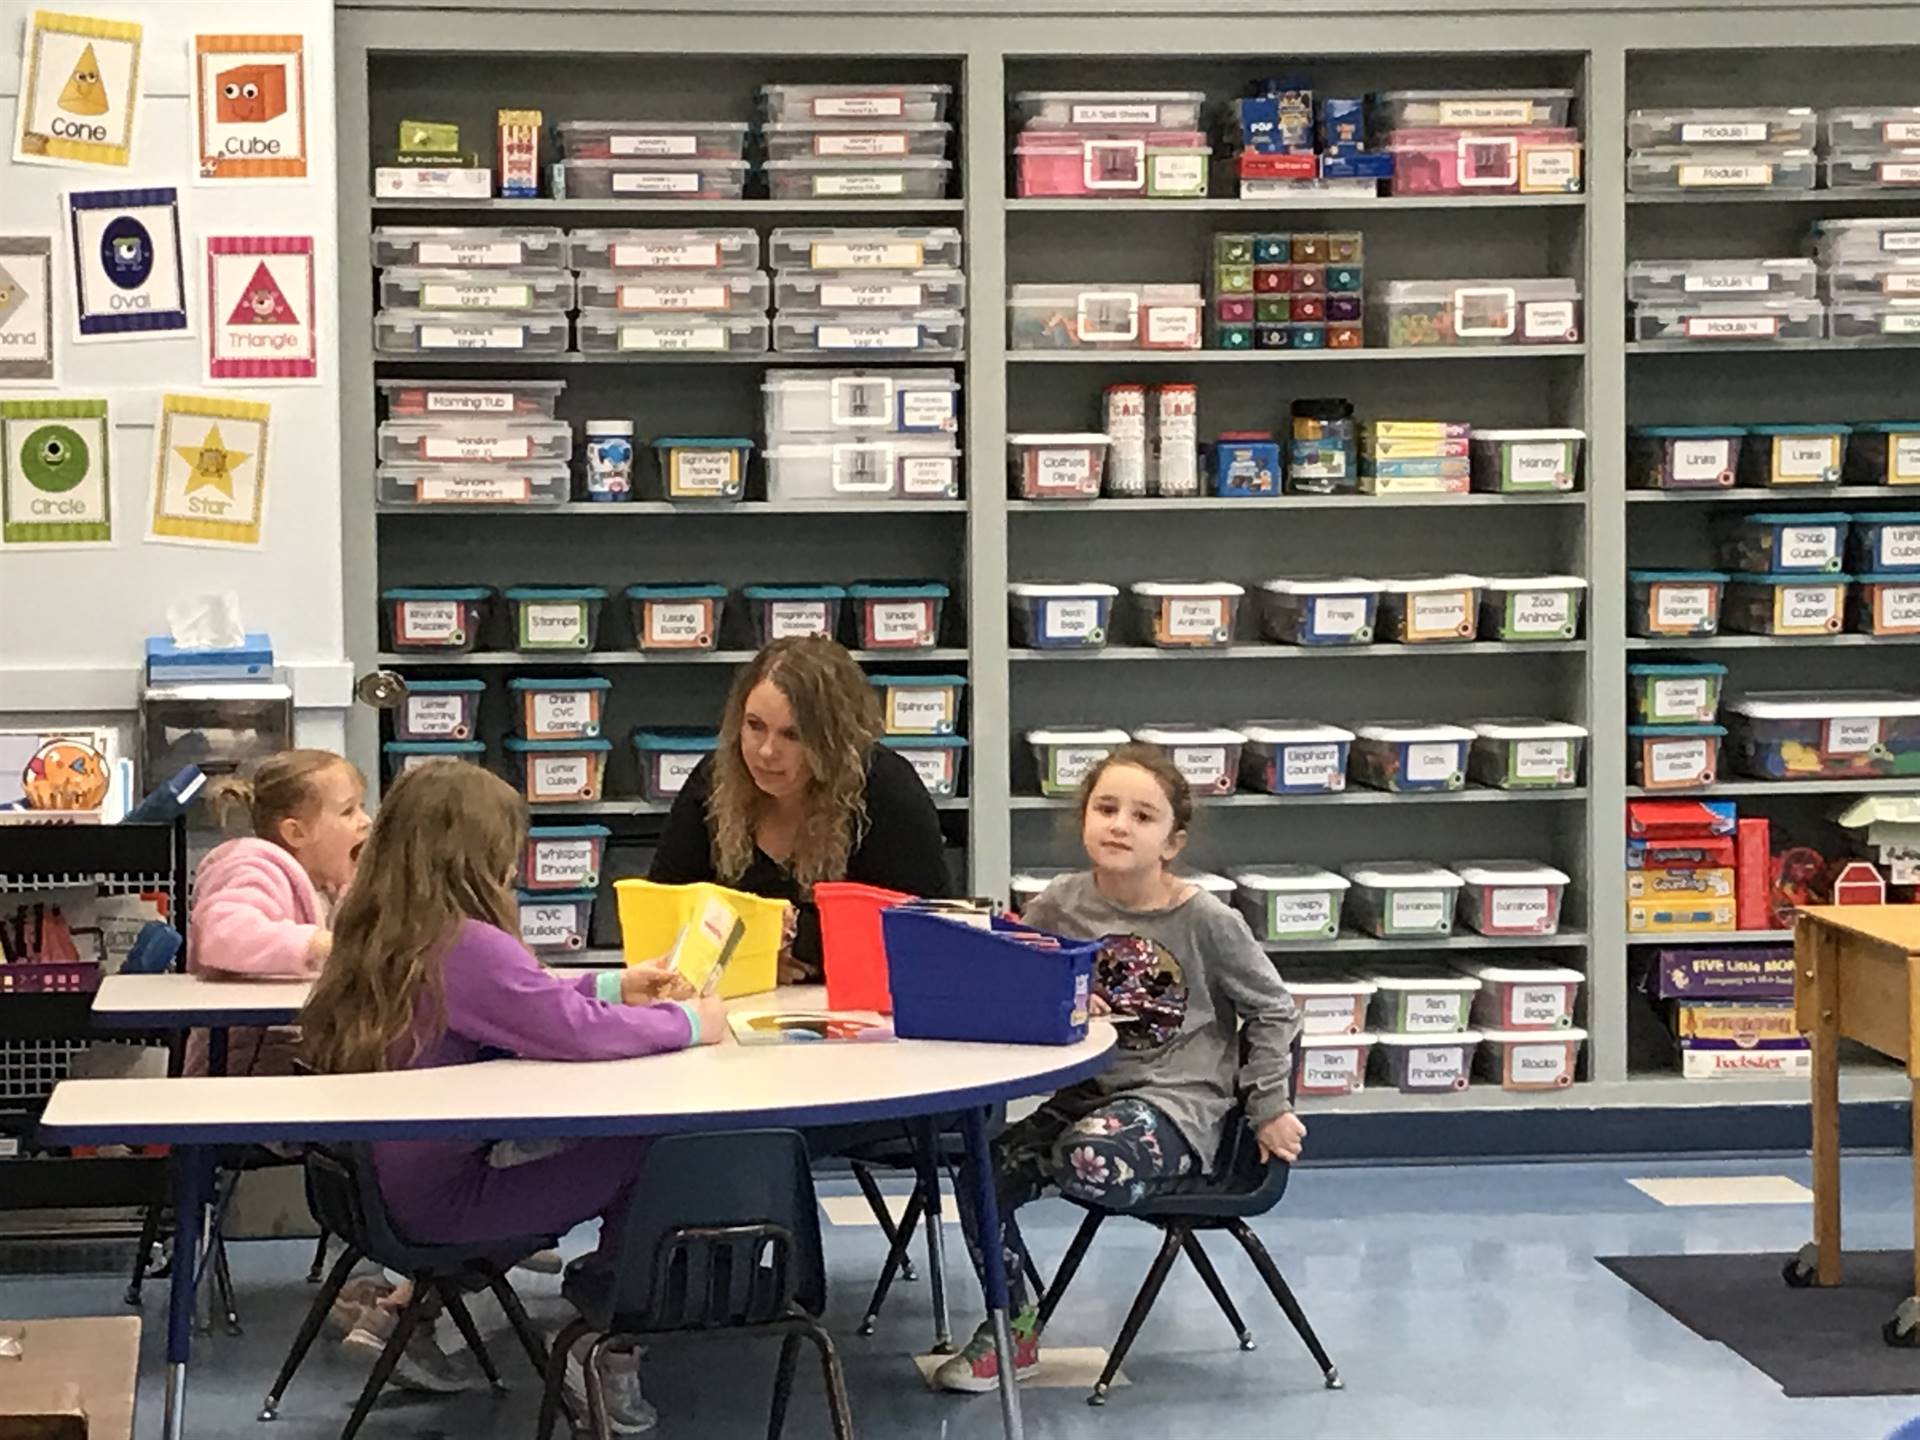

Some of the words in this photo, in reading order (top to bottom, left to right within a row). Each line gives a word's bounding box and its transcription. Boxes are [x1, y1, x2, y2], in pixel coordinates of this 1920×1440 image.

[51, 118, 107, 140] Cone
[225, 137, 281, 155] Cube
[109, 293, 150, 310] Oval
[228, 332, 298, 351] Triangle
[433, 396, 481, 411] Morning
[484, 396, 505, 408] Tub
[1686, 453, 1717, 465] Links
[1792, 449, 1822, 461] Links
[1043, 456, 1086, 469] Clothes
[1052, 471, 1077, 483] Pins
[30, 498, 86, 515] Circle
[187, 496, 232, 516] Star
[1795, 532, 1826, 544] Snap
[1790, 547, 1828, 559] Cubes
[1530, 596, 1555, 608] Zoo
[1795, 591, 1826, 603] Snap
[1517, 611, 1565, 623] Animals
[1791, 607, 1829, 618] Cubes
[531, 614, 578, 628] Stamps
[662, 613, 695, 625] Lacing
[551, 706, 575, 717] CVC
[896, 701, 944, 713] Spinners
[1287, 750, 1337, 762] Elephant
[539, 848, 586, 860] Whisper
[541, 864, 587, 875] Phones
[536, 908, 562, 921] CVC
[1278, 912, 1329, 923] Crawlers
[522, 924, 573, 937] Builders
[1523, 992, 1556, 1003] Bean
[1425, 998, 1447, 1010] Ten
[1410, 1013, 1457, 1024] Frames
[1523, 1007, 1555, 1019] Bags
[1324, 1054, 1345, 1065] Ten
[1427, 1053, 1448, 1064] Ten
[1521, 1058, 1558, 1069] Rocks
[1411, 1067, 1458, 1079] Frames
